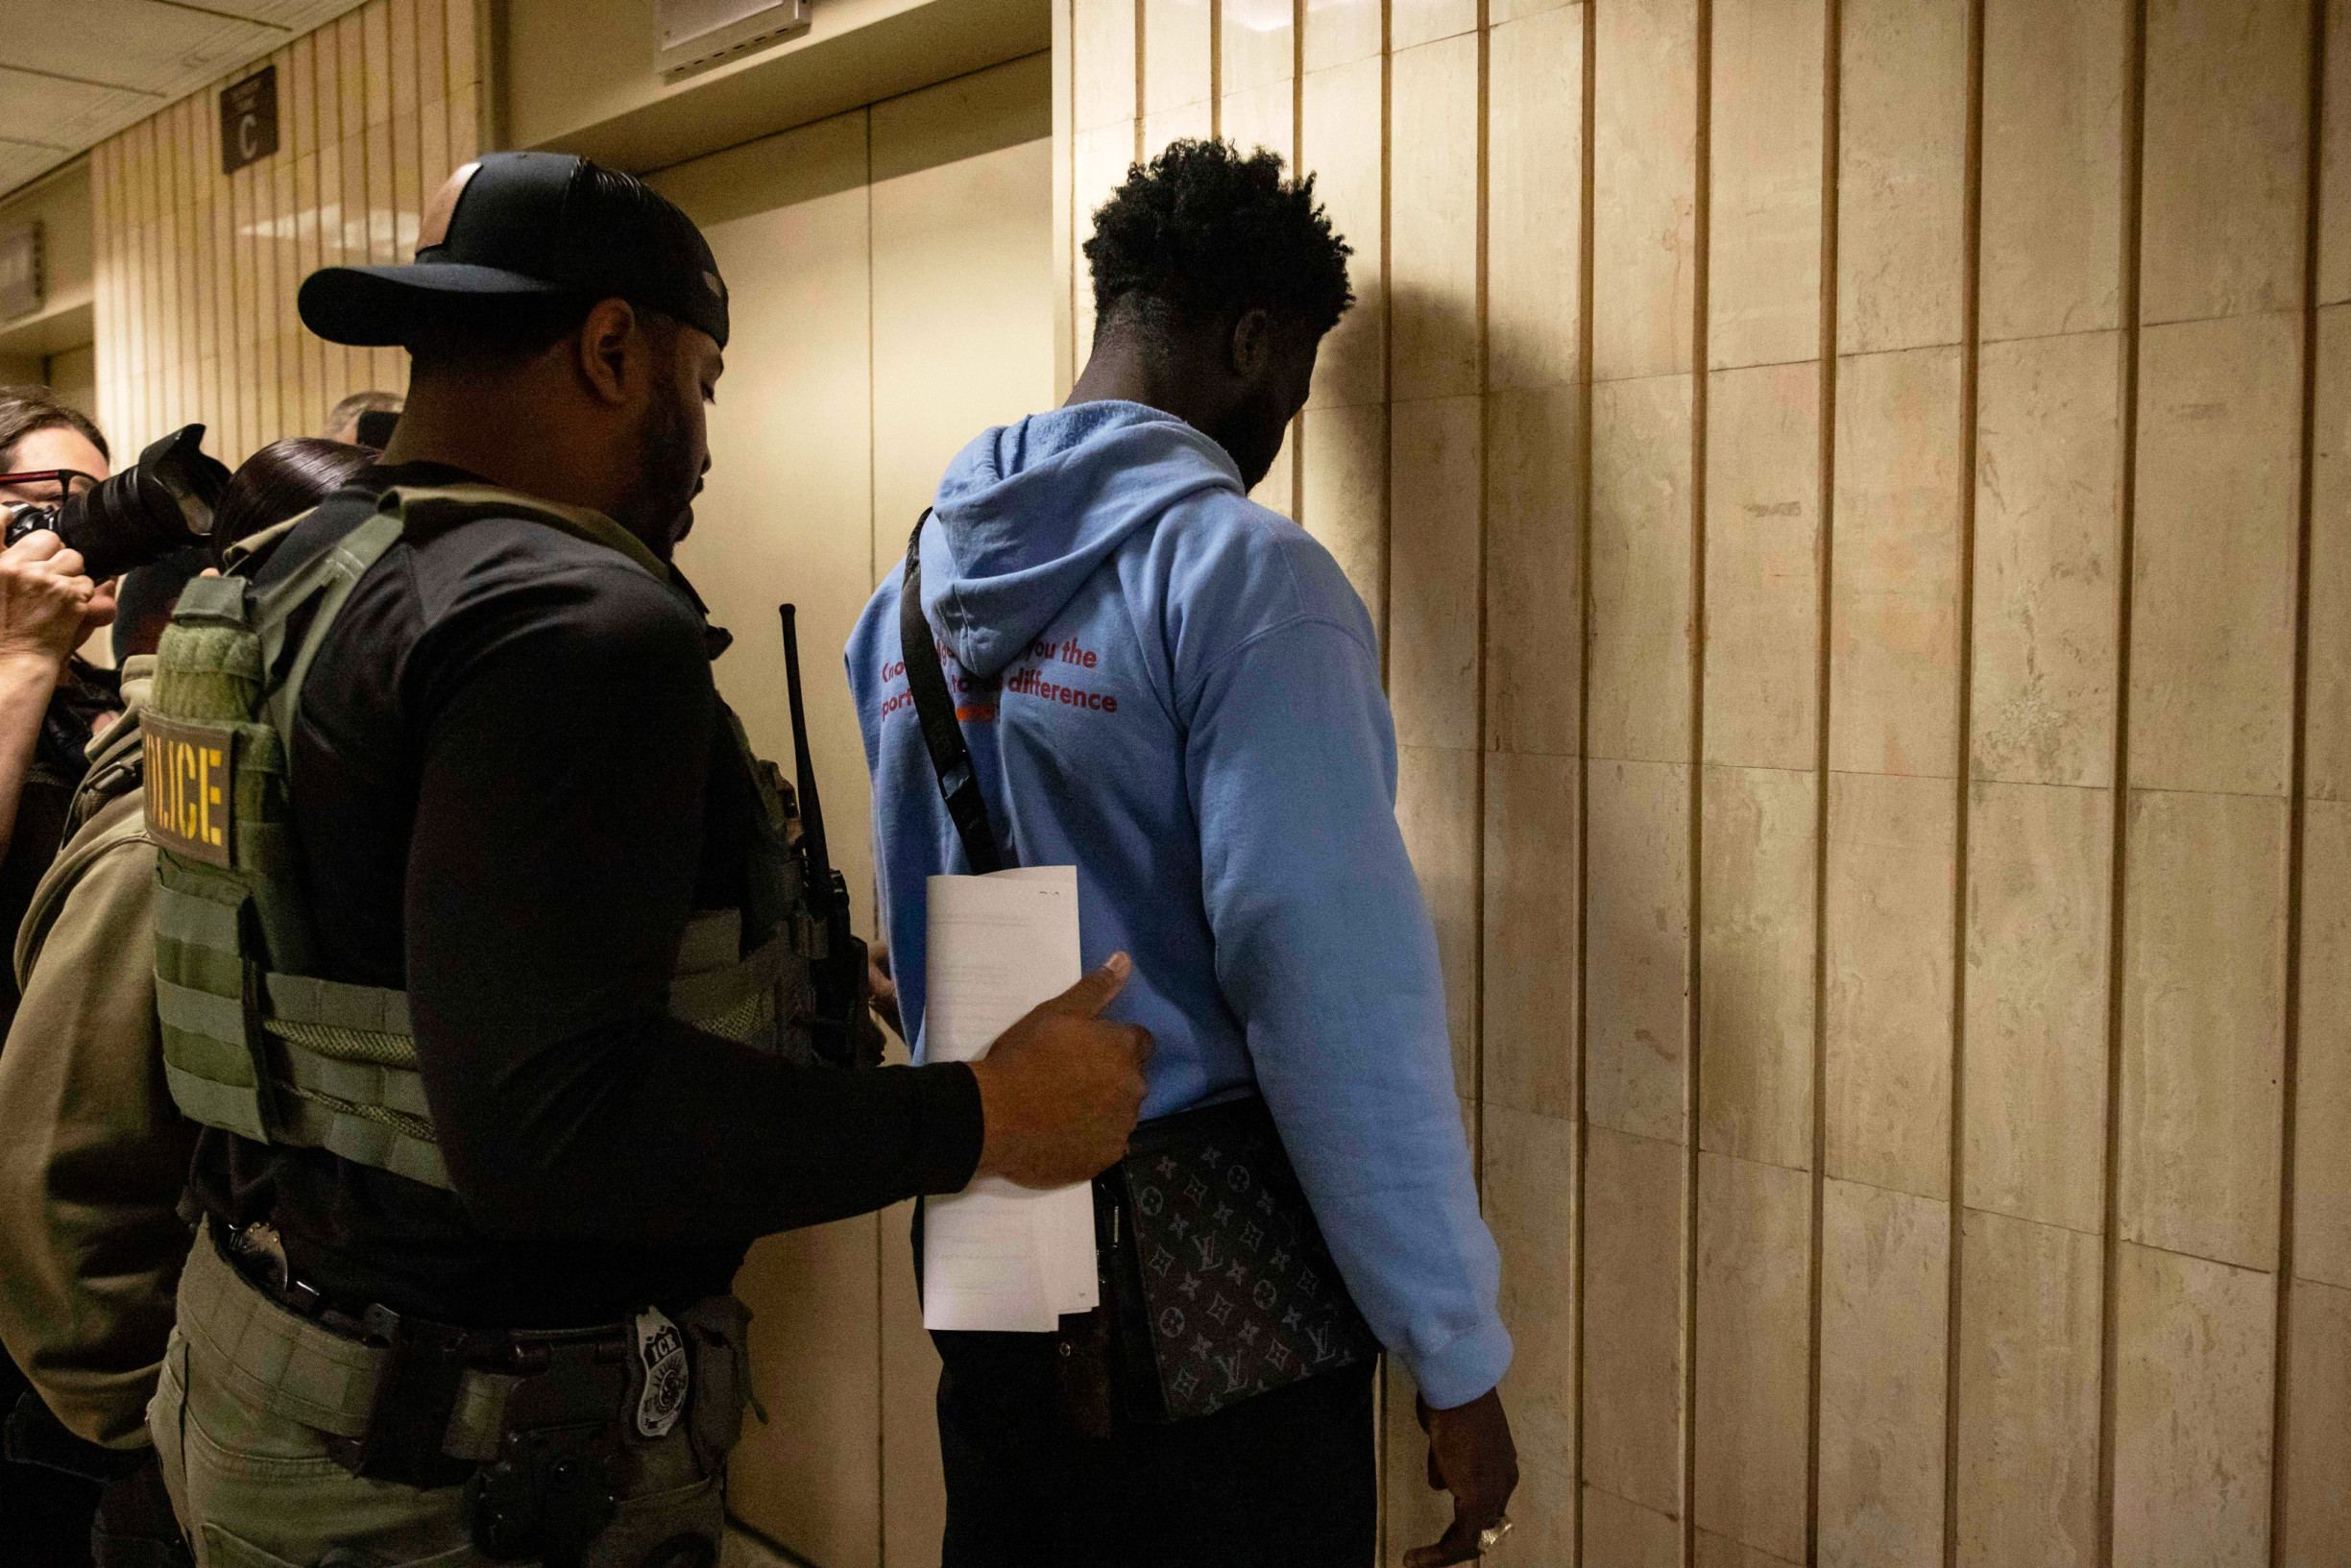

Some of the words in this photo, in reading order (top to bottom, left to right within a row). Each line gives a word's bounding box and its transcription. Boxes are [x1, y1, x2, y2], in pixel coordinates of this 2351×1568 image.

[239, 114, 257, 159] C
[1062, 638, 1097, 668] the
[1007, 667, 1118, 712] difference
[651, 1333, 678, 1363] ICE
